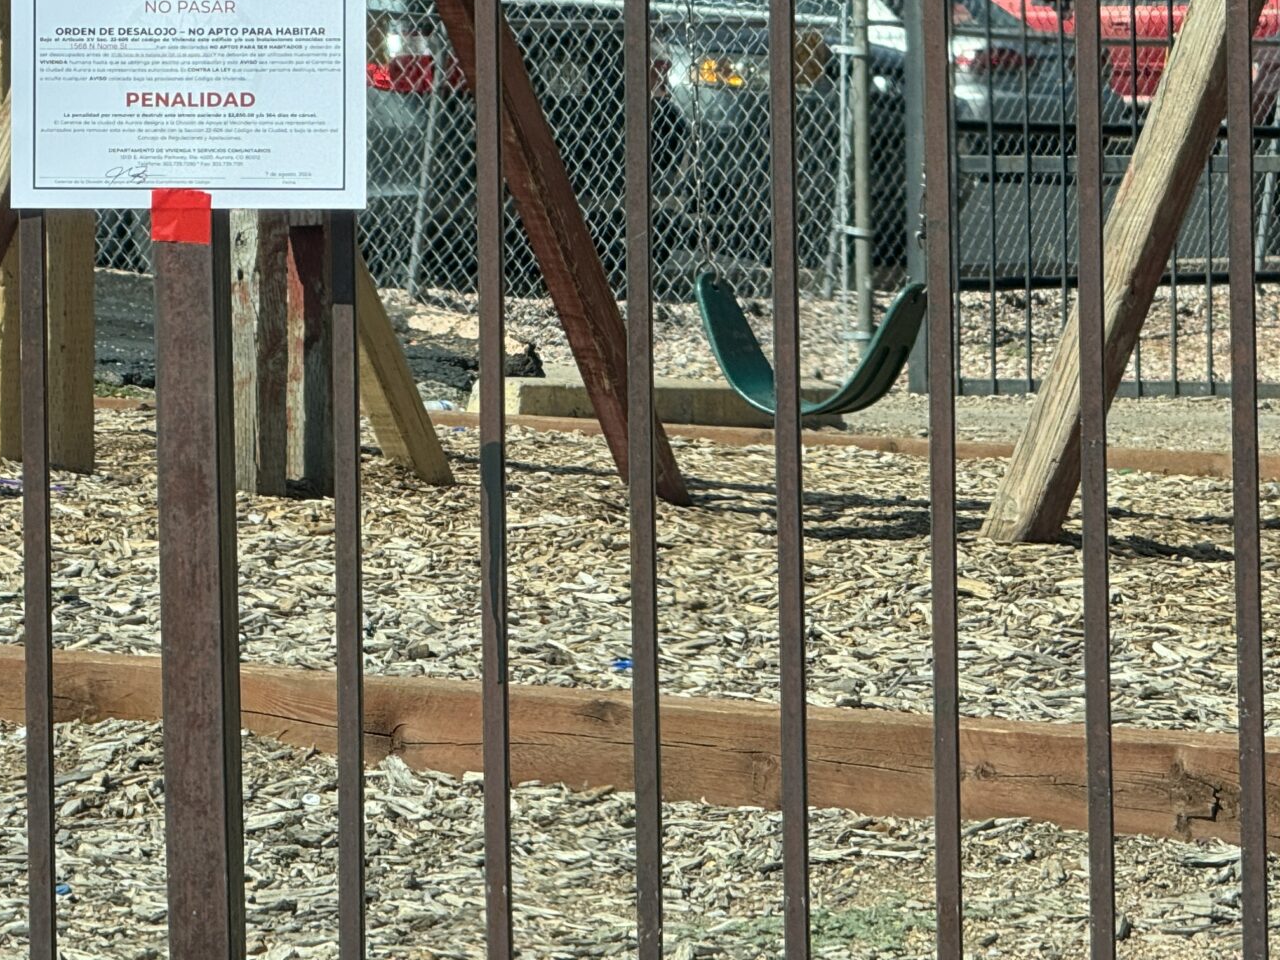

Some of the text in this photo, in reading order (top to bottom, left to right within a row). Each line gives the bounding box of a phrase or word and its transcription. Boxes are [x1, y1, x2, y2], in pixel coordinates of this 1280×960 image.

[145, 0, 236, 14] NO PASAR
[55, 27, 326, 36] ORDEN DE DESALOJO NO APTO PARA HABITAR
[126, 92, 256, 108] PENALIDAD
